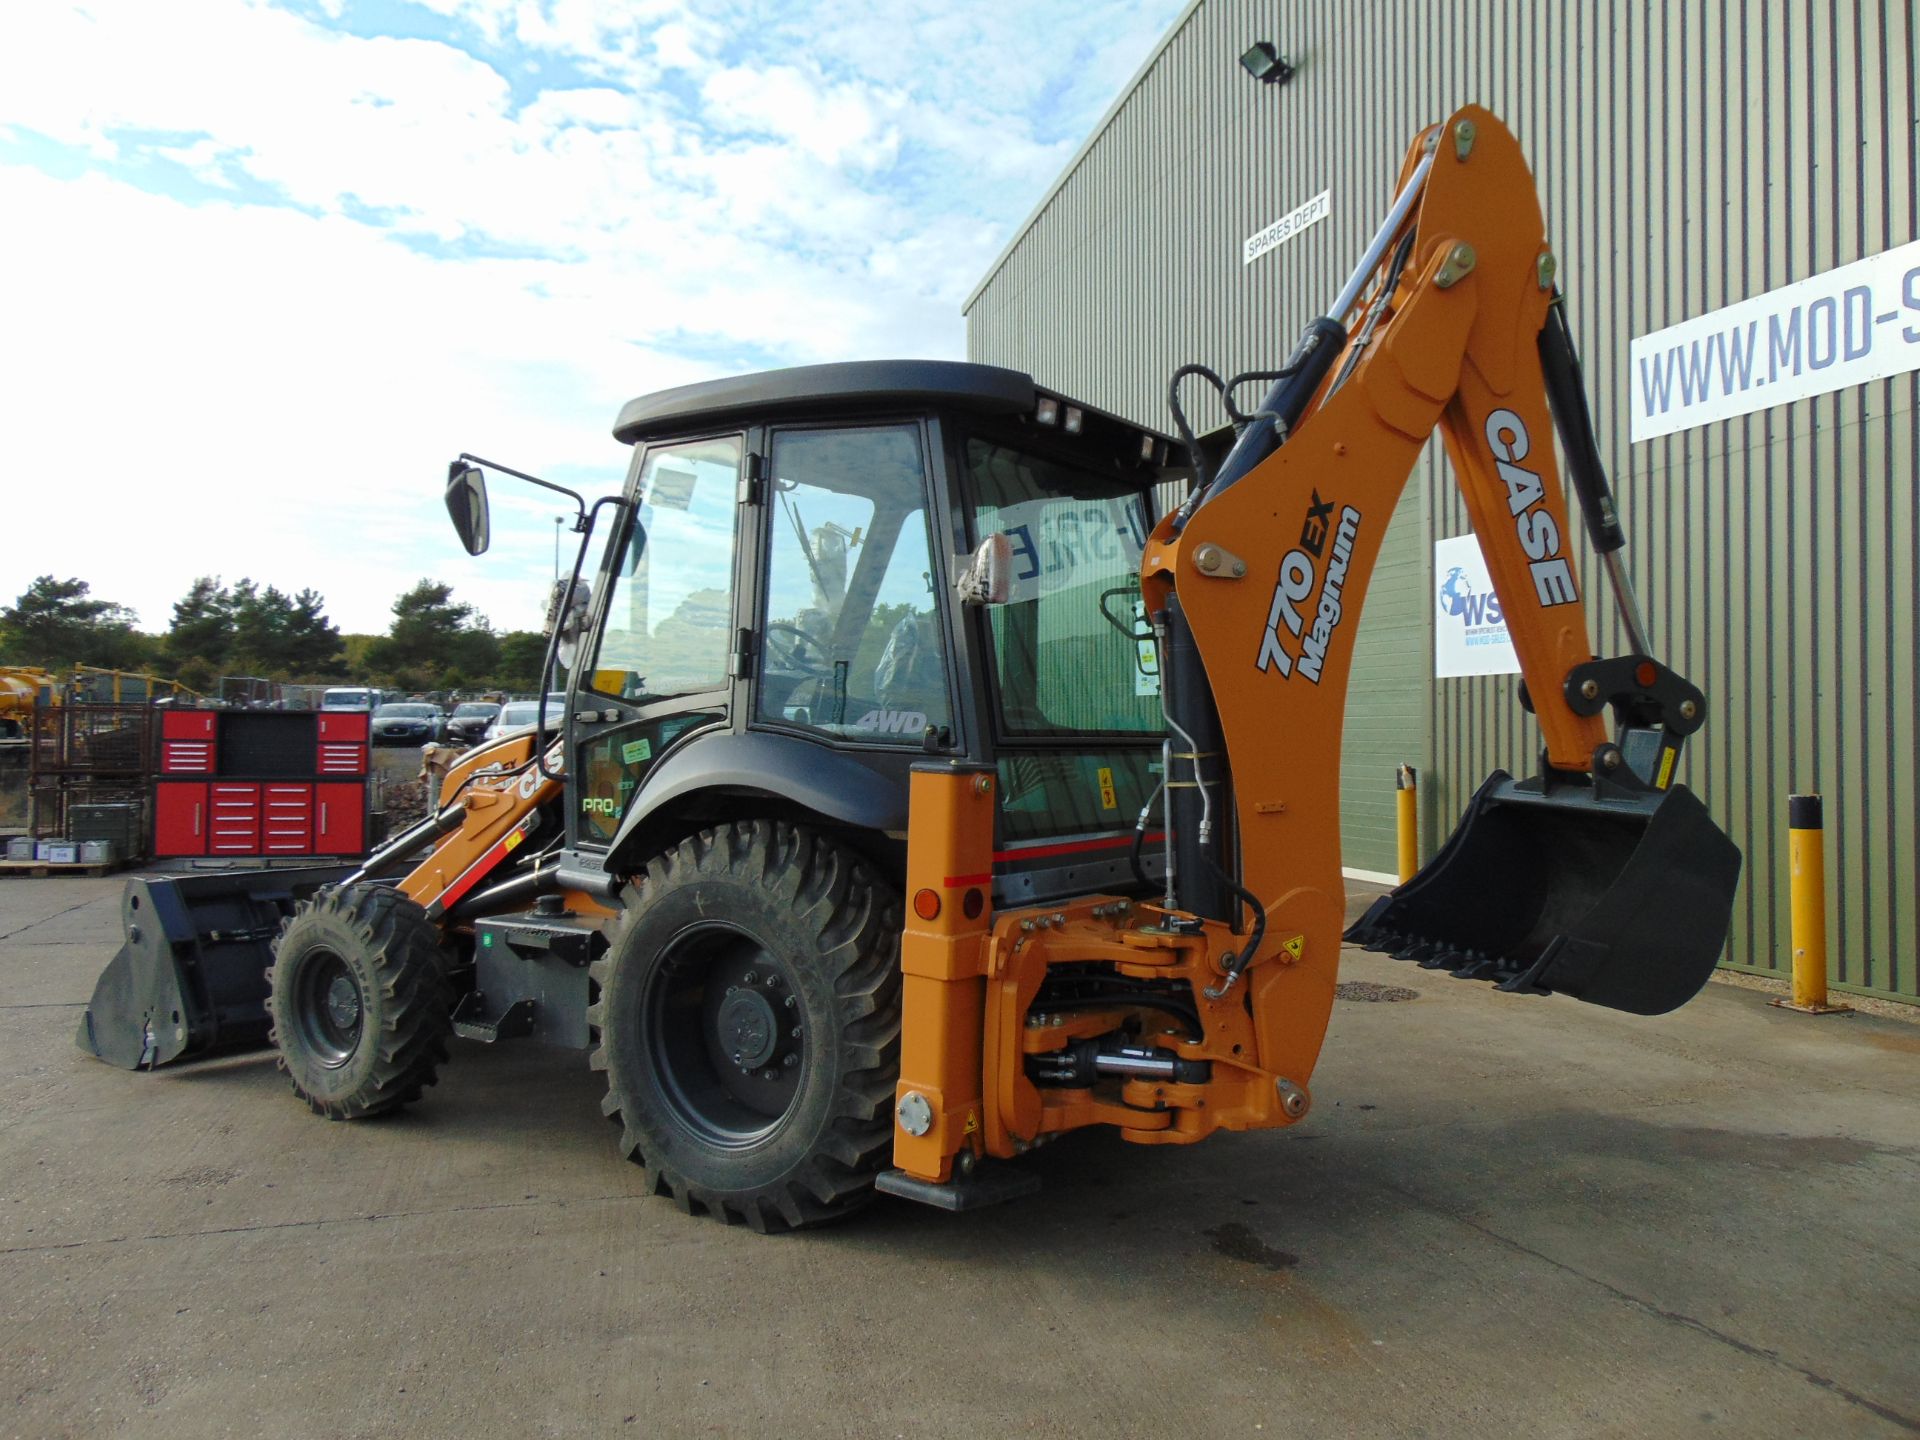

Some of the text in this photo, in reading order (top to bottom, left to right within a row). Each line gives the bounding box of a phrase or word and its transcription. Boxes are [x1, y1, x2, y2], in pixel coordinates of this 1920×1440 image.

[1249, 197, 1325, 257] SPARES DEPT
[1485, 408, 1579, 608] CASE
[1255, 487, 1335, 680] 770 EX
[1296, 504, 1361, 686] Magnum
[856, 710, 927, 733] 4WD
[583, 798, 613, 812] PRO
